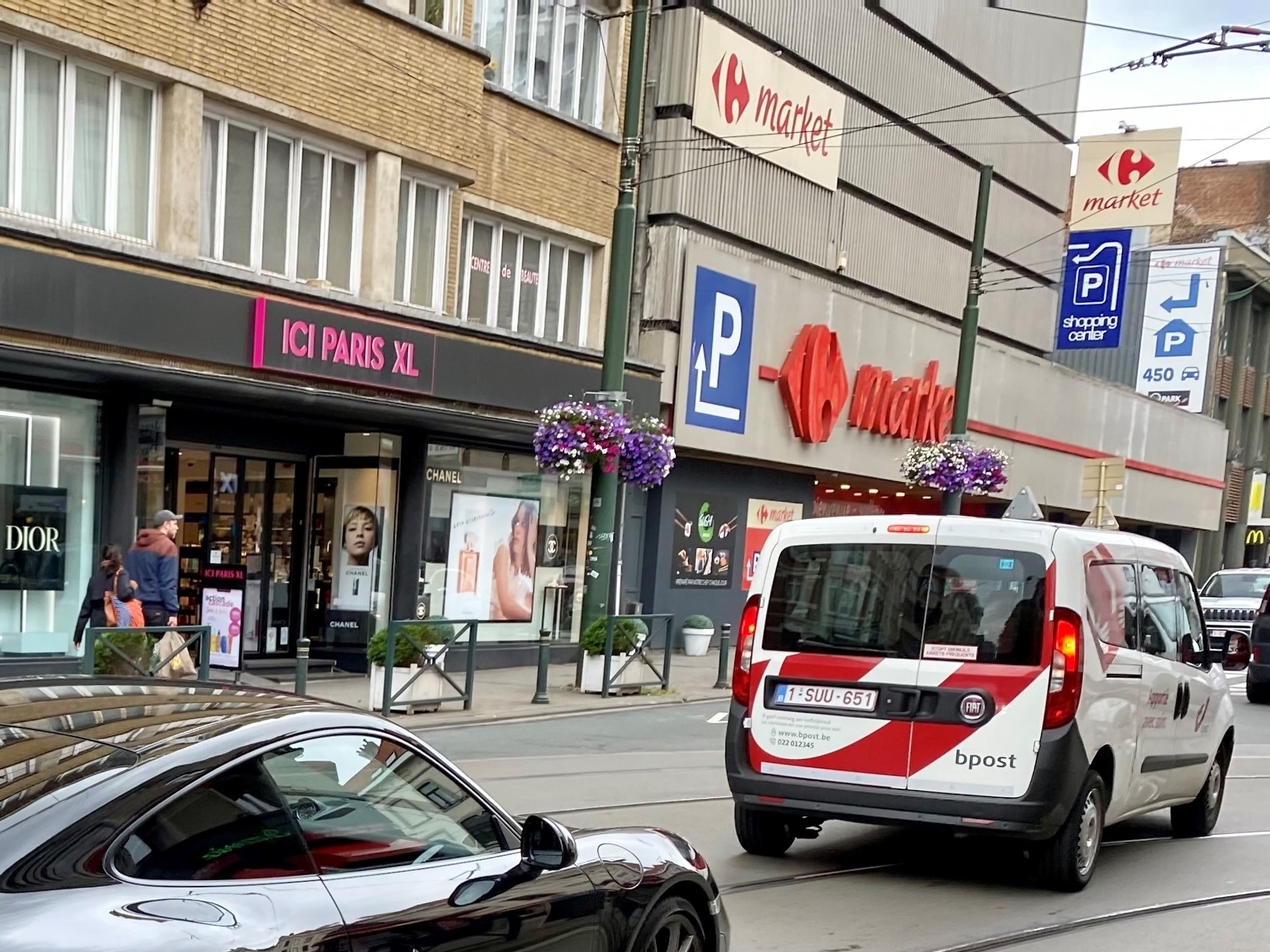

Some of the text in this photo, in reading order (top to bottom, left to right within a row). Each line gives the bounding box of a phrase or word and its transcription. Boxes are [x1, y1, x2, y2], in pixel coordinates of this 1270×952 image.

[755, 85, 833, 157] market
[1083, 188, 1163, 212] market
[471, 256, 490, 274] CENTRE
[502, 264, 511, 278] de
[1063, 313, 1118, 329] shopping
[709, 292, 742, 389] P
[1068, 327, 1107, 341] center
[282, 319, 419, 377] ICI PARIS XL
[1143, 367, 1174, 382] 450
[426, 468, 462, 484] CHANEL
[5, 525, 60, 552] DIOR
[205, 569, 215, 577] ICI
[216, 569, 235, 578] PARIS
[966, 702, 981, 713] FIAT
[778, 731, 831, 741] www.bpost.be
[955, 749, 1017, 769] bpost
